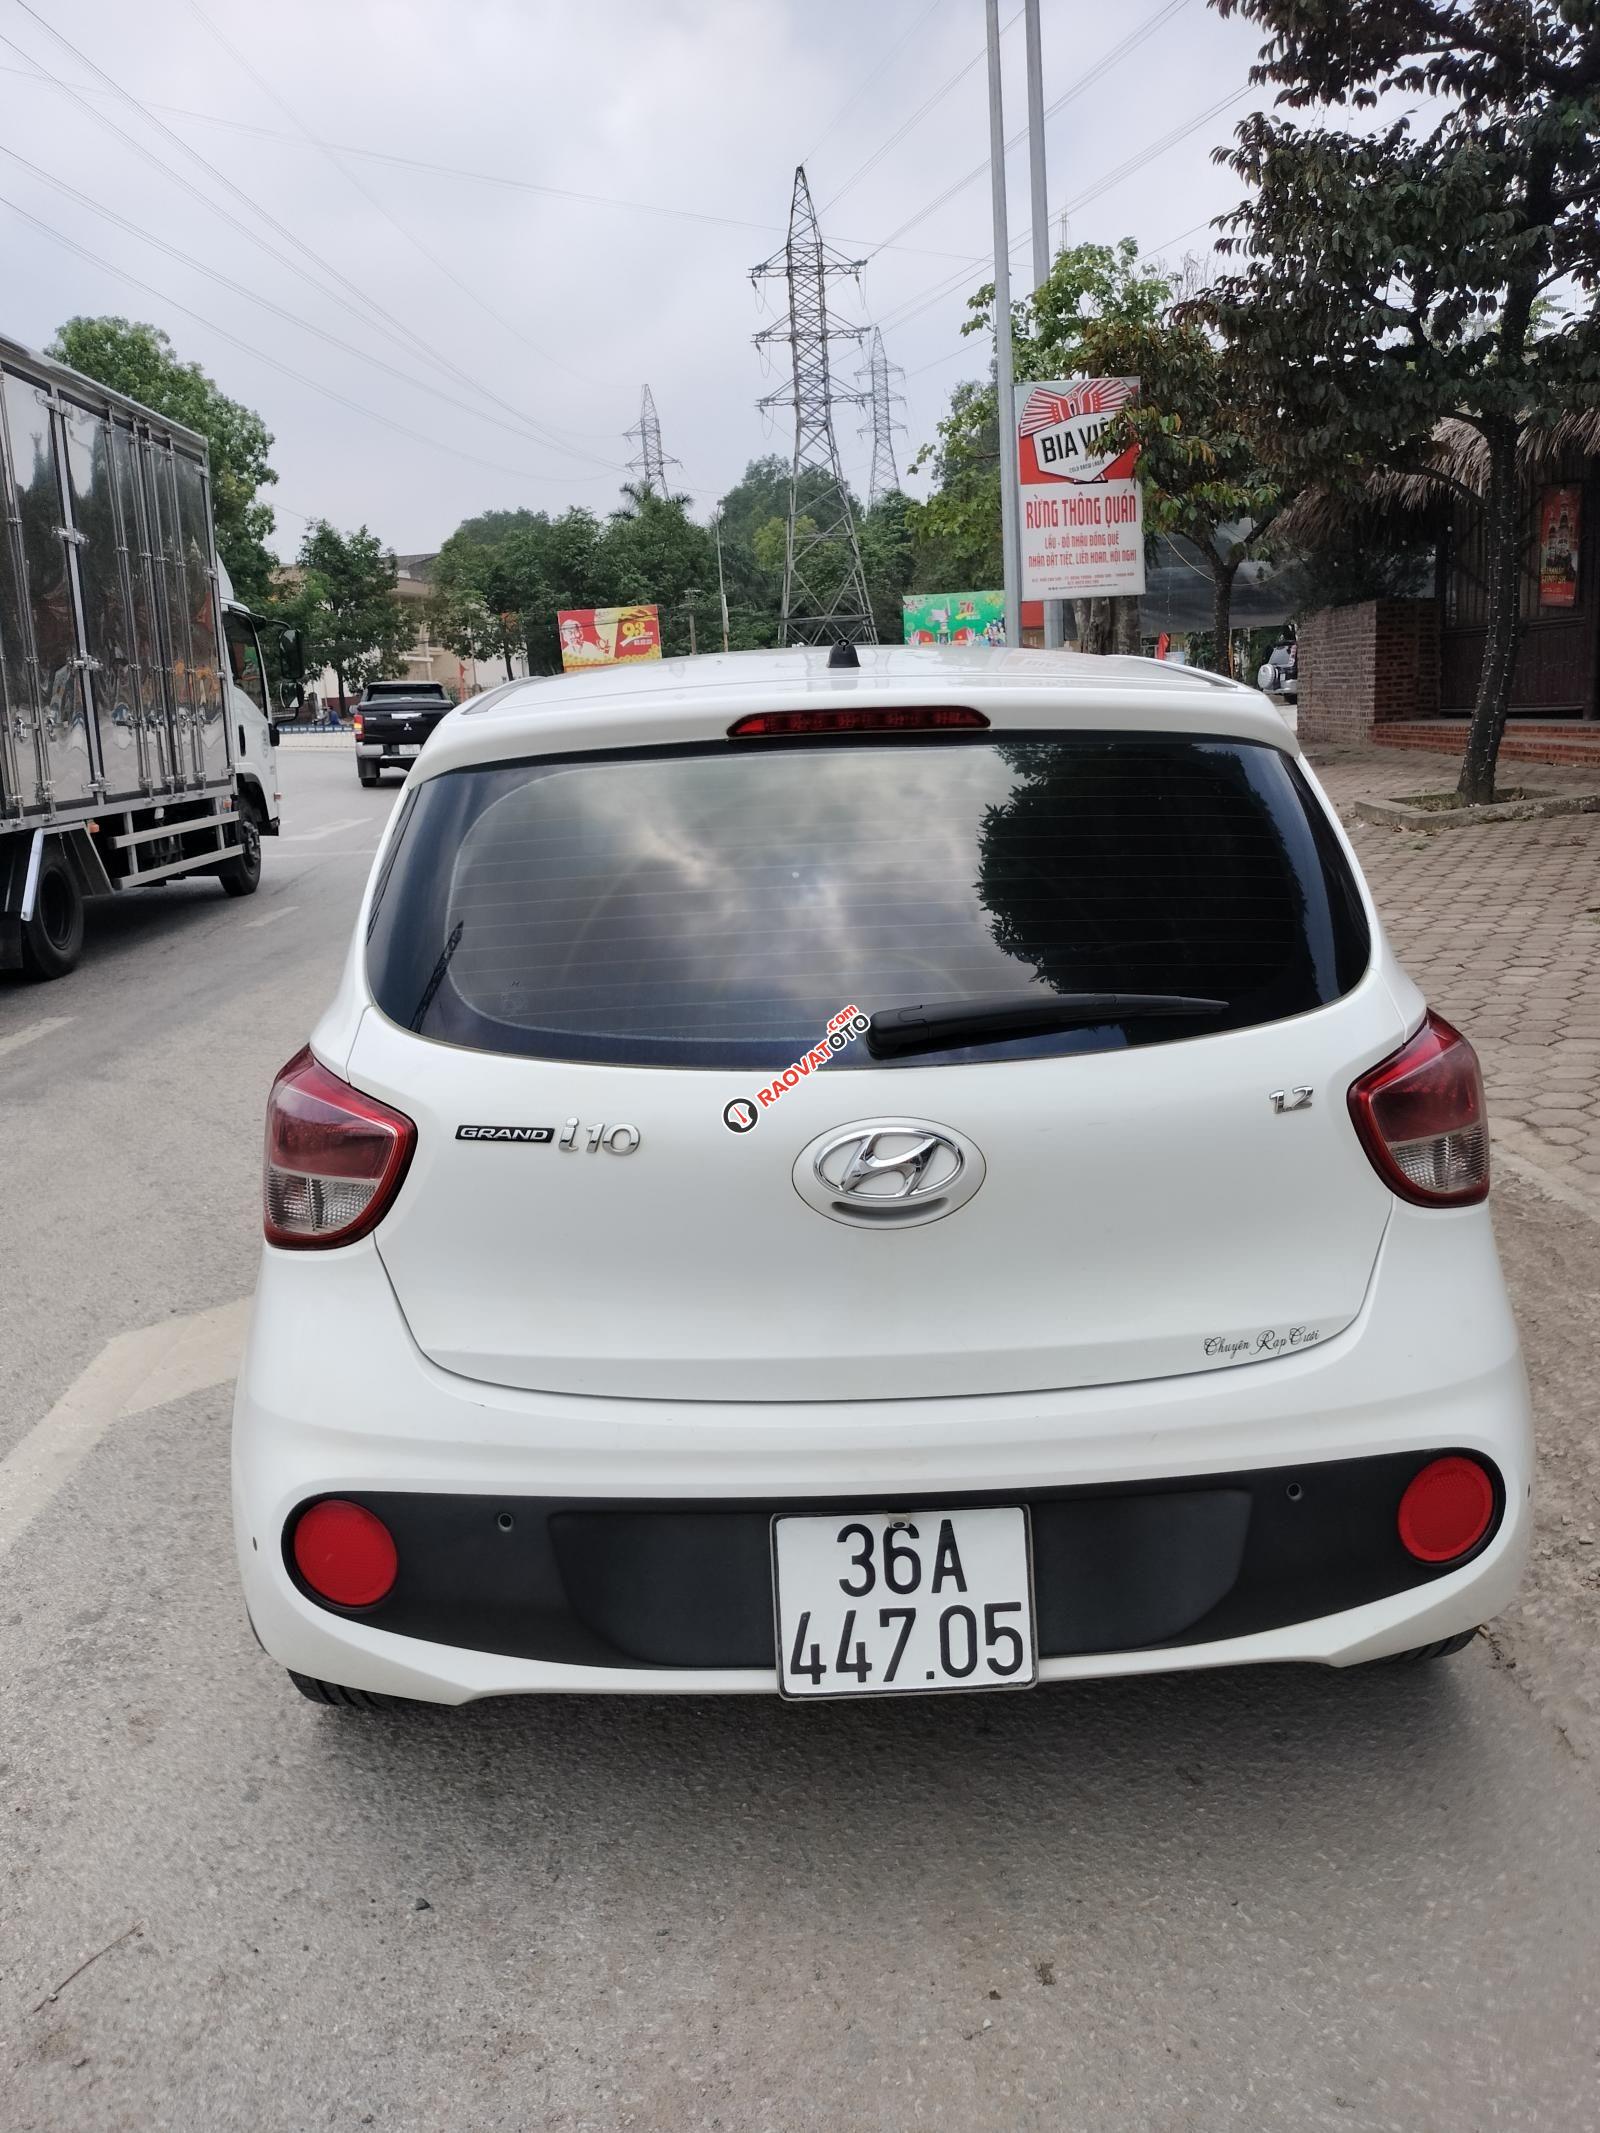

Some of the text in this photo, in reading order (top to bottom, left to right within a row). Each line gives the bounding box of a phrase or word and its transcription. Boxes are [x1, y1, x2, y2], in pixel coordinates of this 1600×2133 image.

[1040, 431, 1078, 464] BIA
[1026, 489, 1137, 529] RỪNG THÔNG QUÁN
[622, 621, 646, 637] 93
[460, 1117, 641, 1156] GRAND i10
[1203, 1336, 1250, 1360] Chuyên
[836, 1518, 968, 1598] 36A
[790, 1601, 1024, 1685] 447.05
